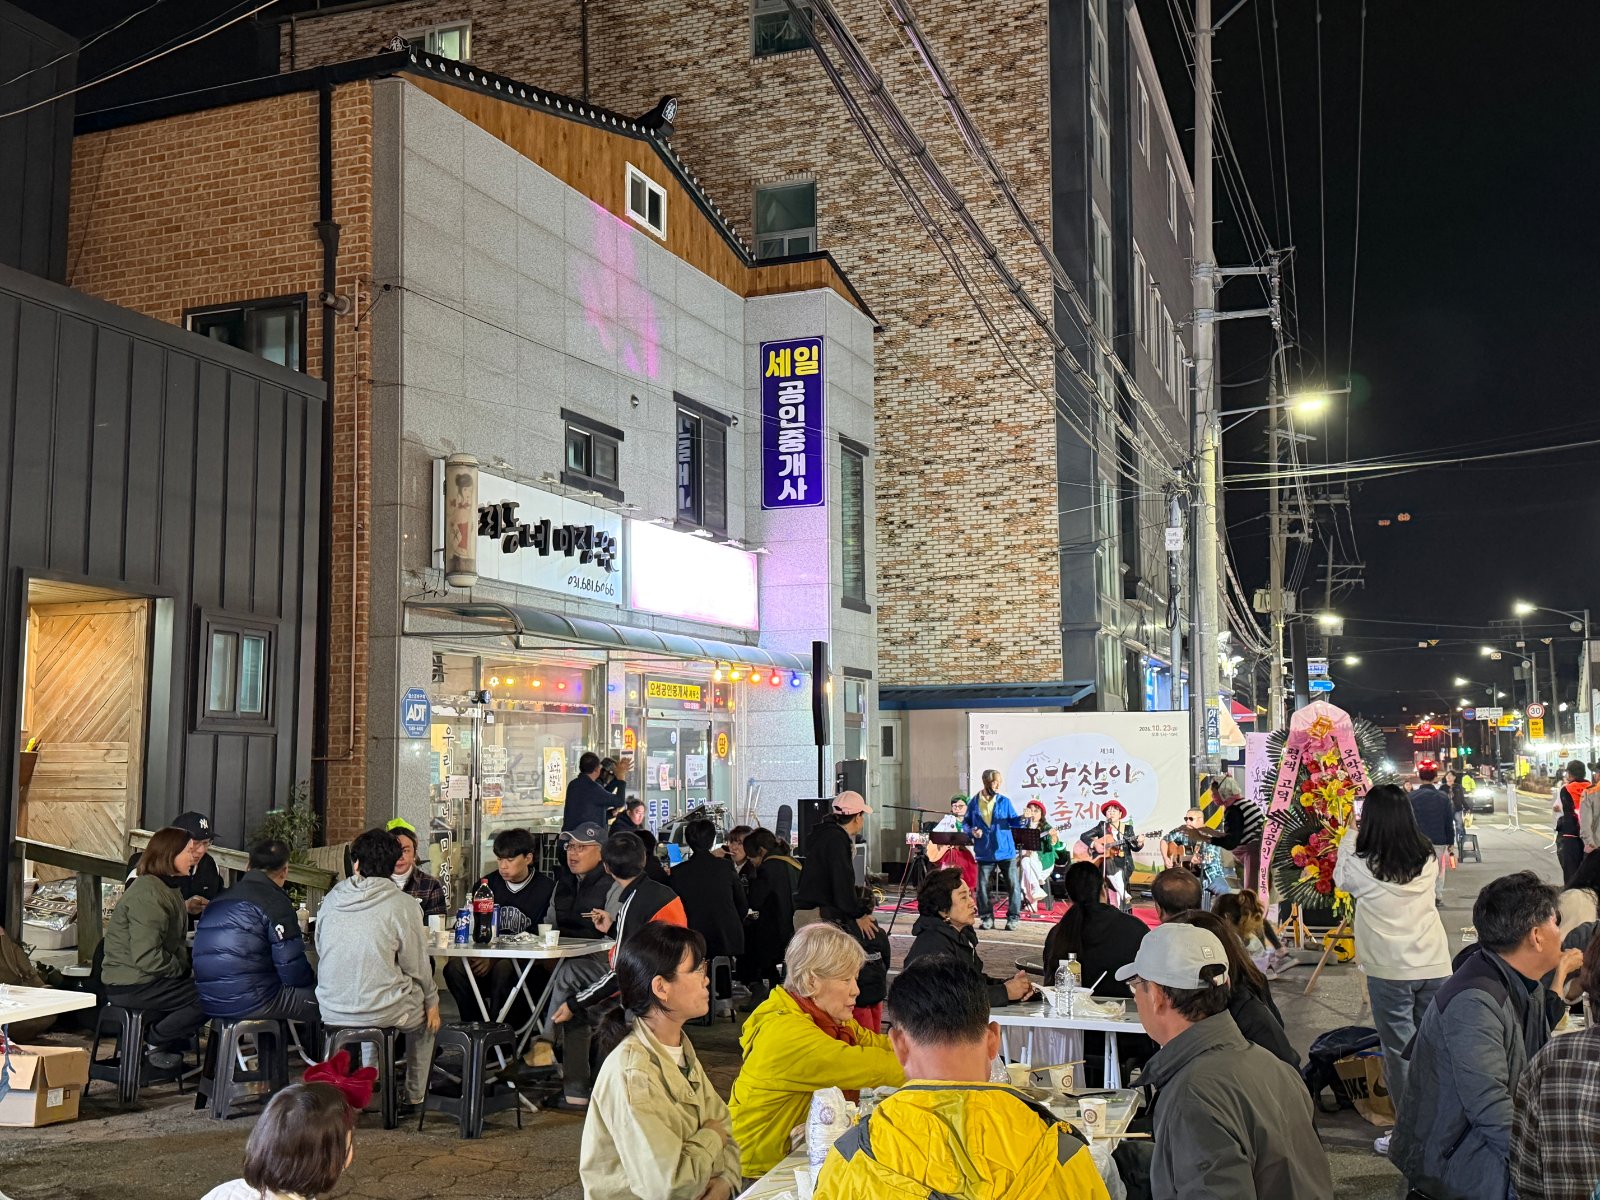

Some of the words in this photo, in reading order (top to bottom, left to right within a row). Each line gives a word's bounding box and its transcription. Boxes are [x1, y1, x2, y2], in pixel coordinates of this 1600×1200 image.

[765, 345, 819, 377] 세일
[778, 380, 808, 501] 공인중개사
[568, 575, 615, 597] 031.681.6066
[405, 703, 427, 723] ADT
[1530, 707, 1541, 715] 30
[1050, 796, 1102, 822] 축제
